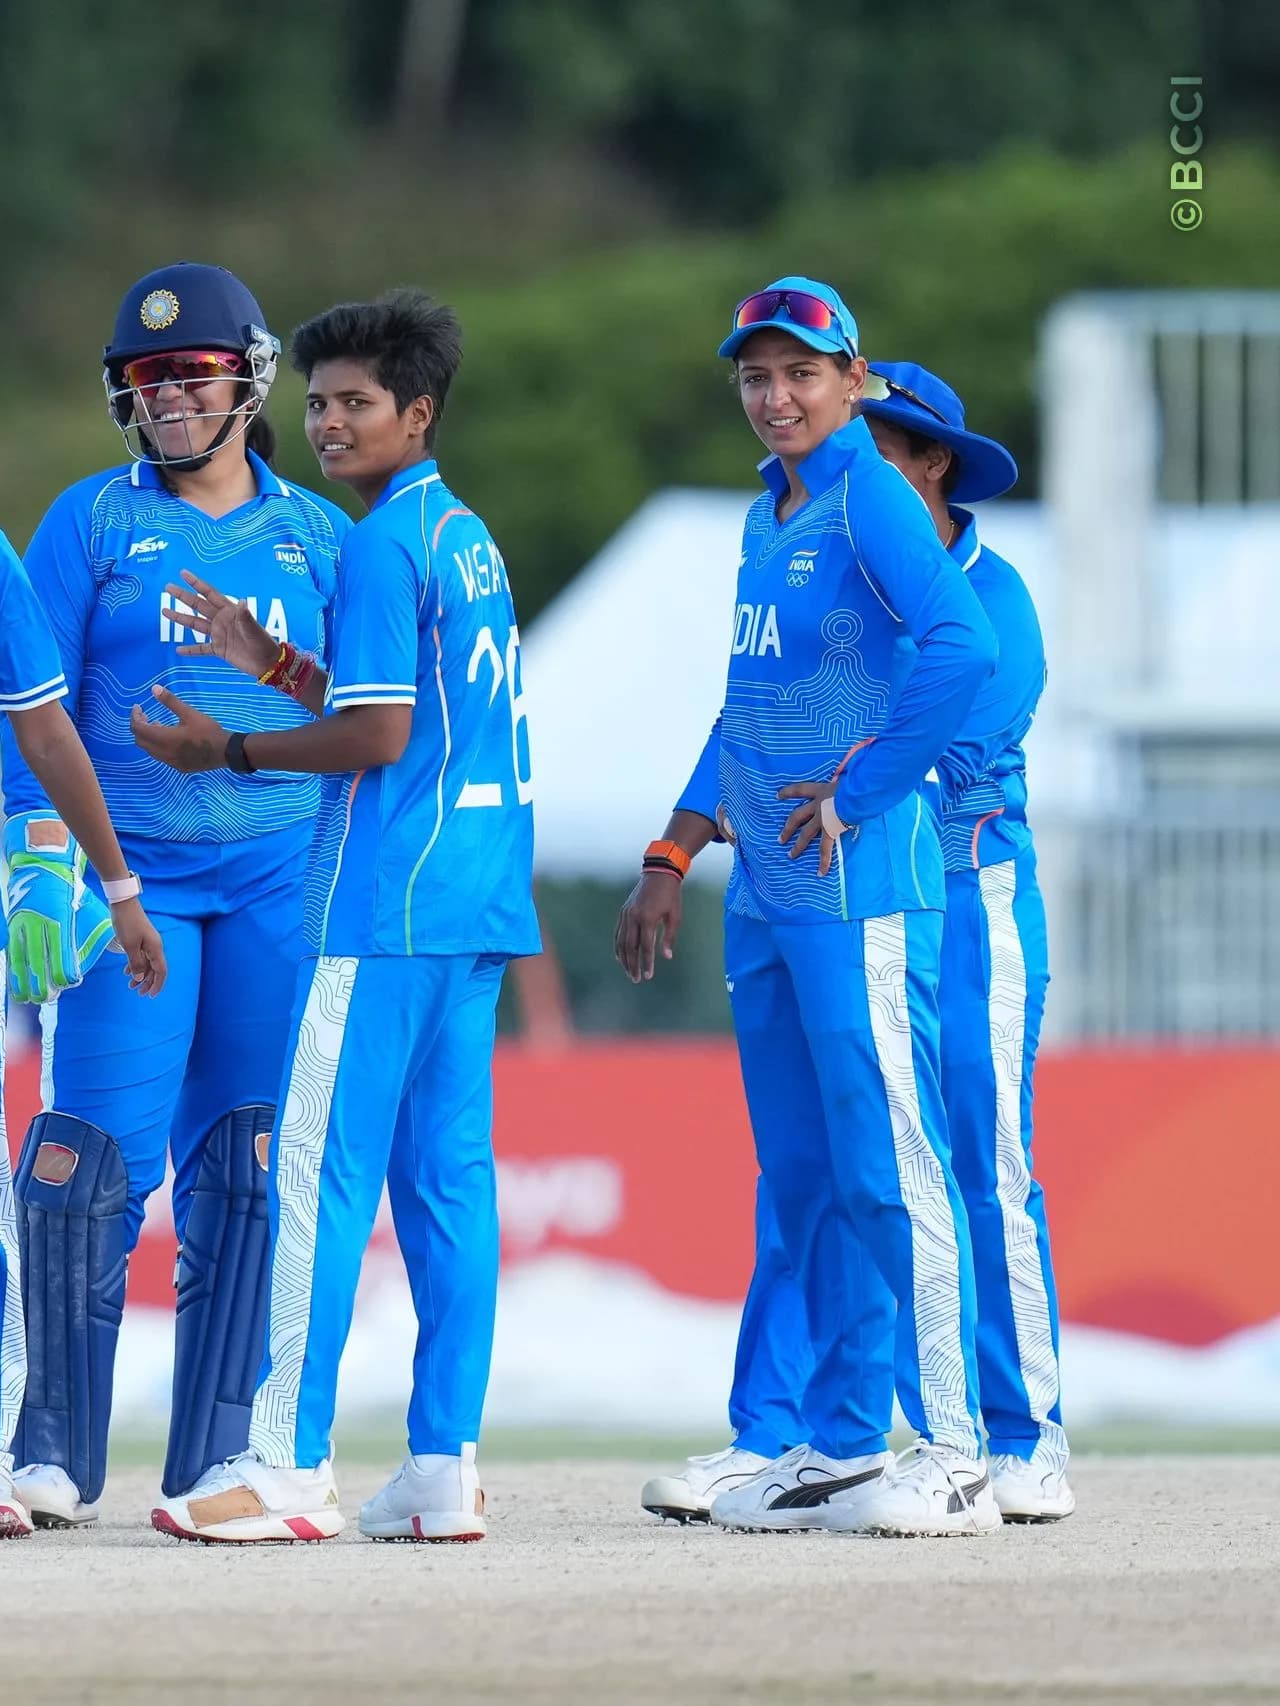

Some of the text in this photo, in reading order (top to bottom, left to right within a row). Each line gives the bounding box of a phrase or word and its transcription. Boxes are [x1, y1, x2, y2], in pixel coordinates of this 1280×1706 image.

[124, 540, 169, 559] JSW
[788, 559, 815, 572] INDIA
[732, 603, 782, 658] DIA
